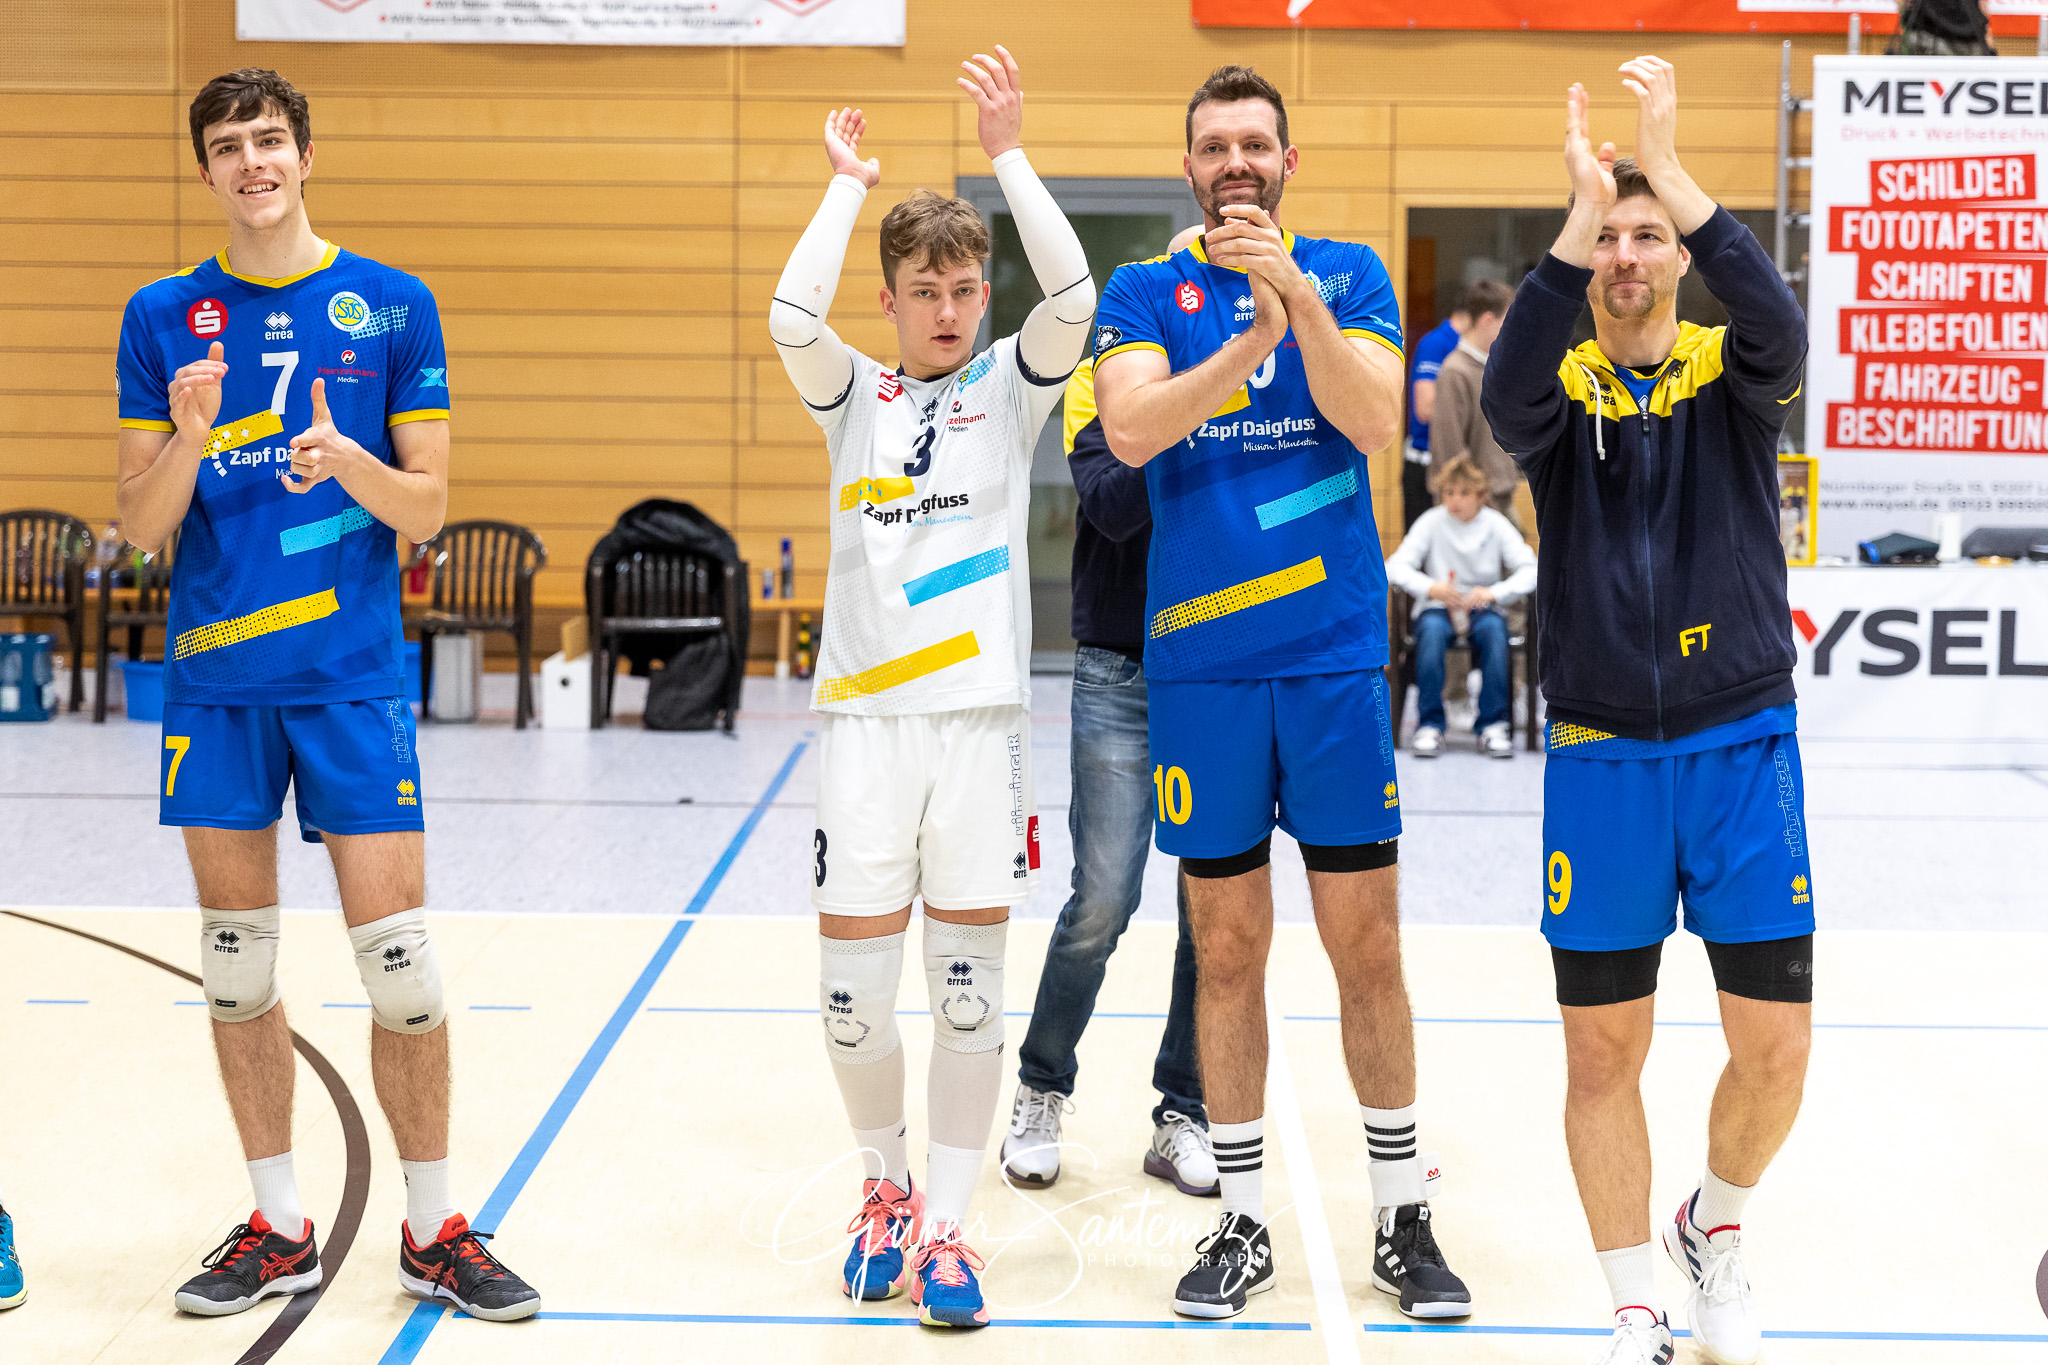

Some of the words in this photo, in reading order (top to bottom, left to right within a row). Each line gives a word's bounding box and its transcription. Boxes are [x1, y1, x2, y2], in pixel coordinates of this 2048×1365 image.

[1925, 126, 2048, 142] Werbetechn
[1877, 158, 2026, 202] SCHILDER
[1842, 211, 2048, 251] FOTOTAPETEN
[1869, 260, 2033, 303] SCHRIFTEN
[1234, 311, 1256, 321] erre
[1850, 312, 2048, 353] KLEBEFOLIEN
[261, 351, 299, 415] 7
[318, 366, 378, 377] Heinzelmann
[336, 376, 359, 384] Medien
[1865, 362, 2039, 404] FAHRZEUG-
[946, 413, 986, 425] zelmann
[1197, 421, 1240, 441] Zapf
[1243, 417, 1316, 438] Daigfuss
[1836, 407, 2048, 450] BESCHRIFTUN
[229, 446, 272, 468] Zapf
[904, 425, 936, 477] 3
[863, 501, 903, 526] Zapf
[906, 493, 970, 523] Dgfuss
[1679, 623, 1712, 657] FT
[1790, 609, 2048, 677] YSEL
[165, 736, 191, 796] 7
[1153, 764, 1193, 825] 10
[814, 828, 828, 887] 3
[1548, 850, 1573, 915] 9
